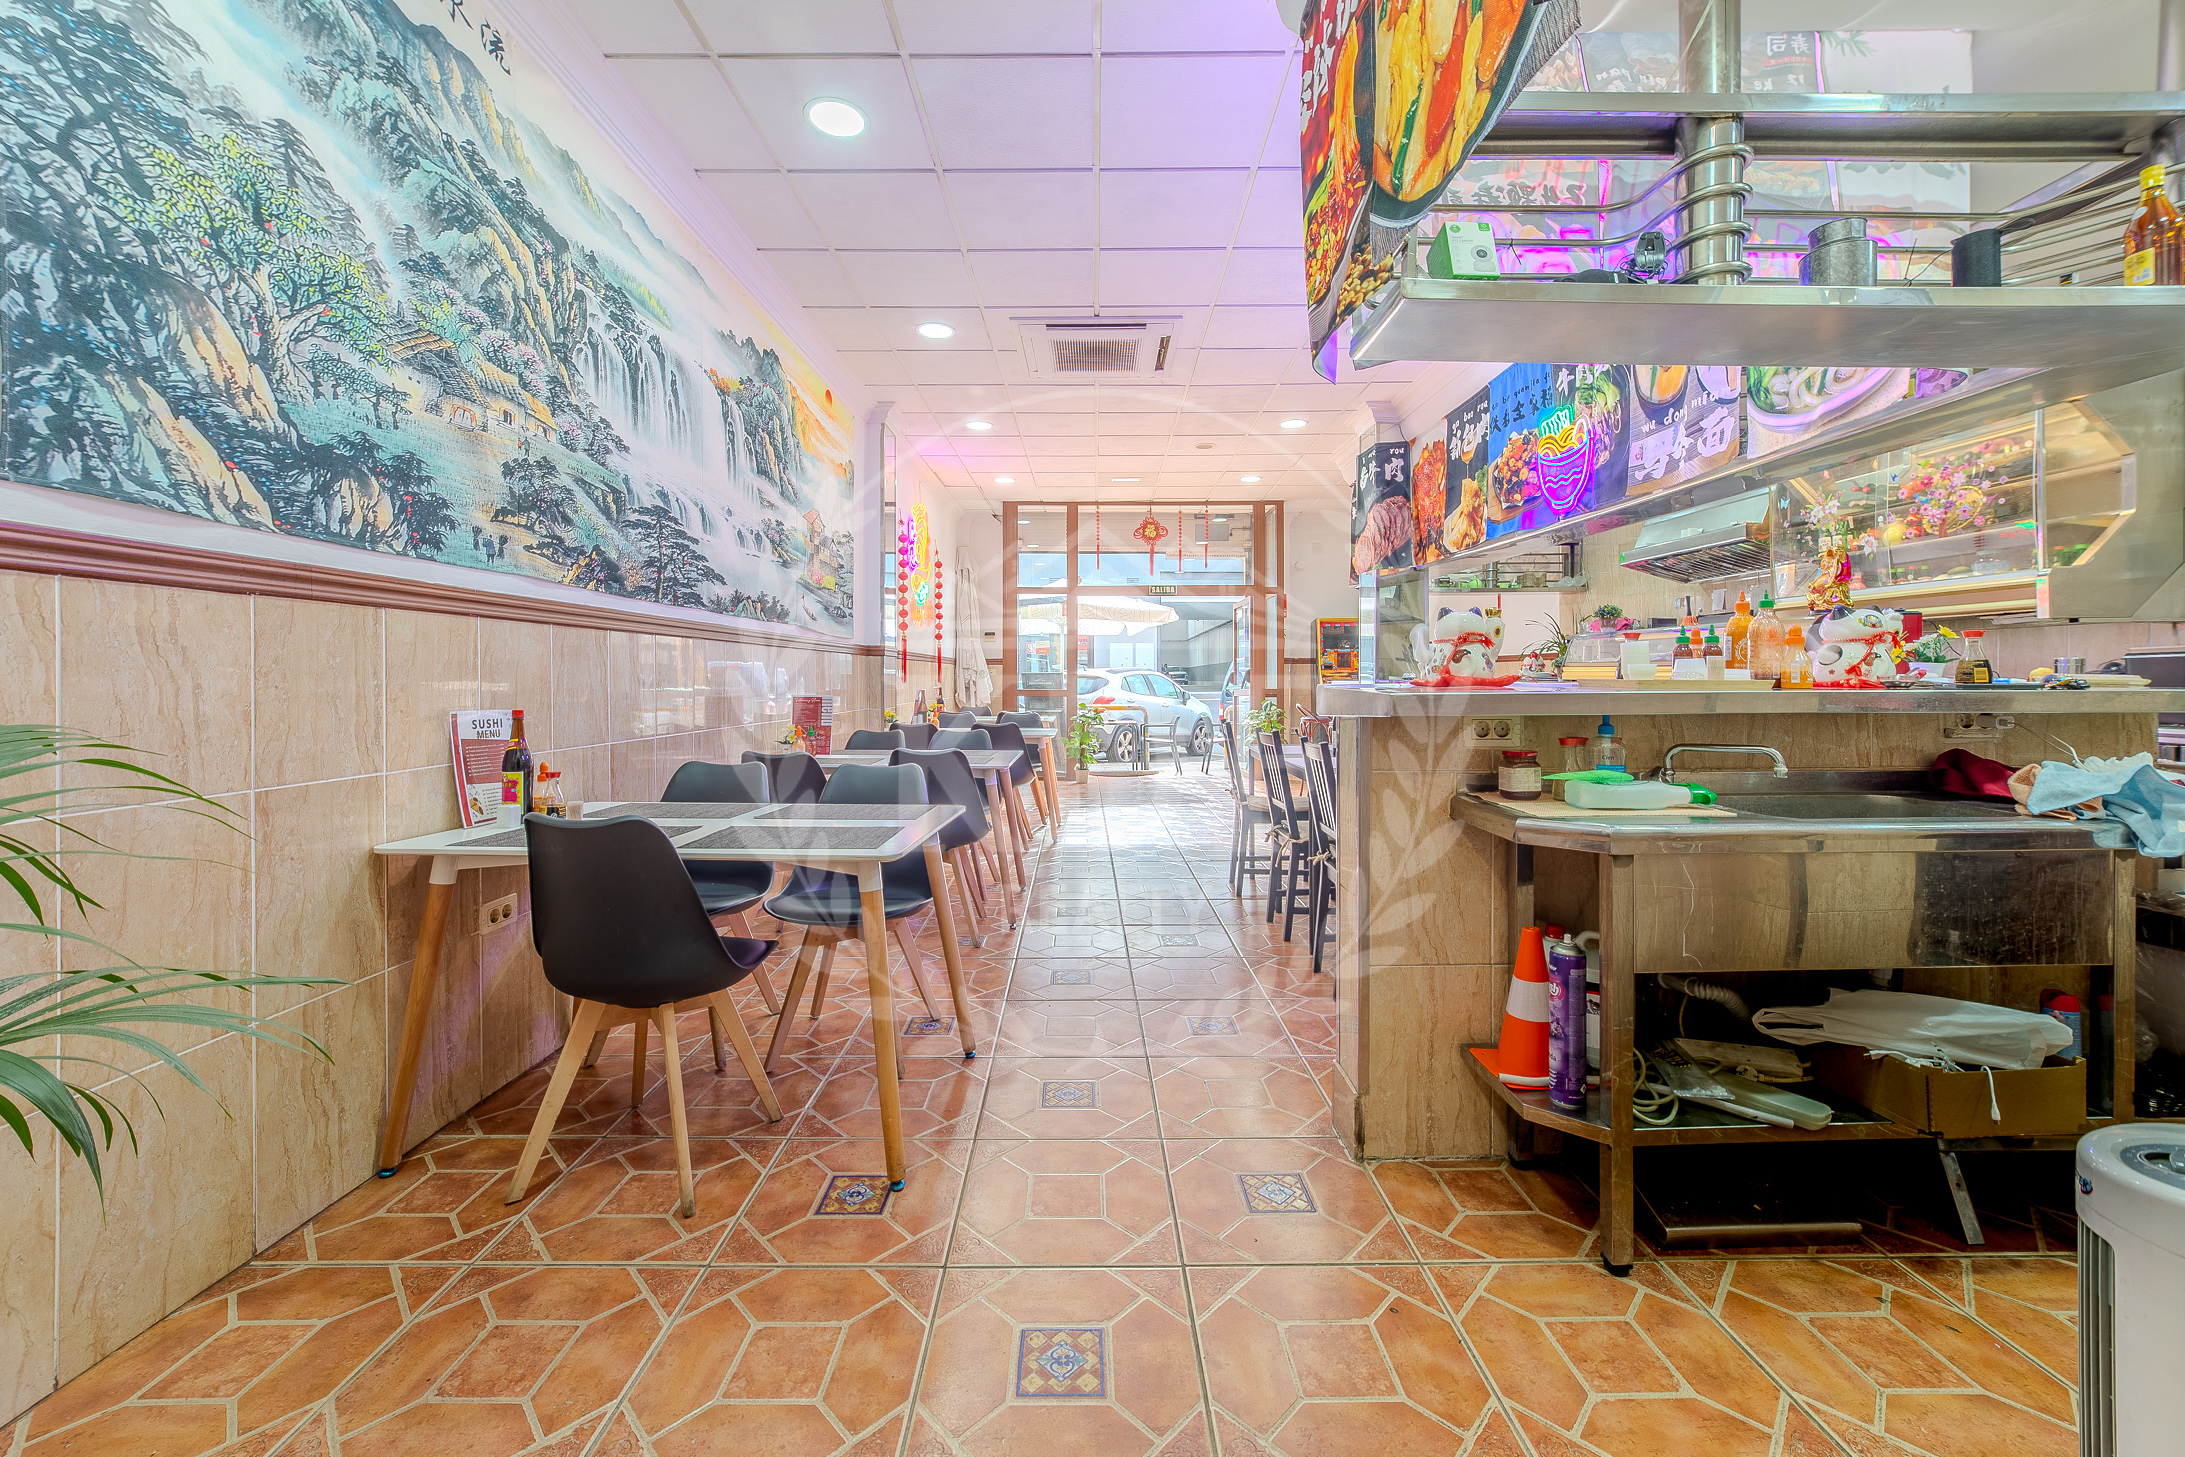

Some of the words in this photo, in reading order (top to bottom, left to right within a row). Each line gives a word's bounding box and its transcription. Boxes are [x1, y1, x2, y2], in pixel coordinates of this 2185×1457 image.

[1151, 586, 1175, 594] SALIDA
[472, 718, 503, 730] SUSHI
[476, 729, 501, 740] MENU
